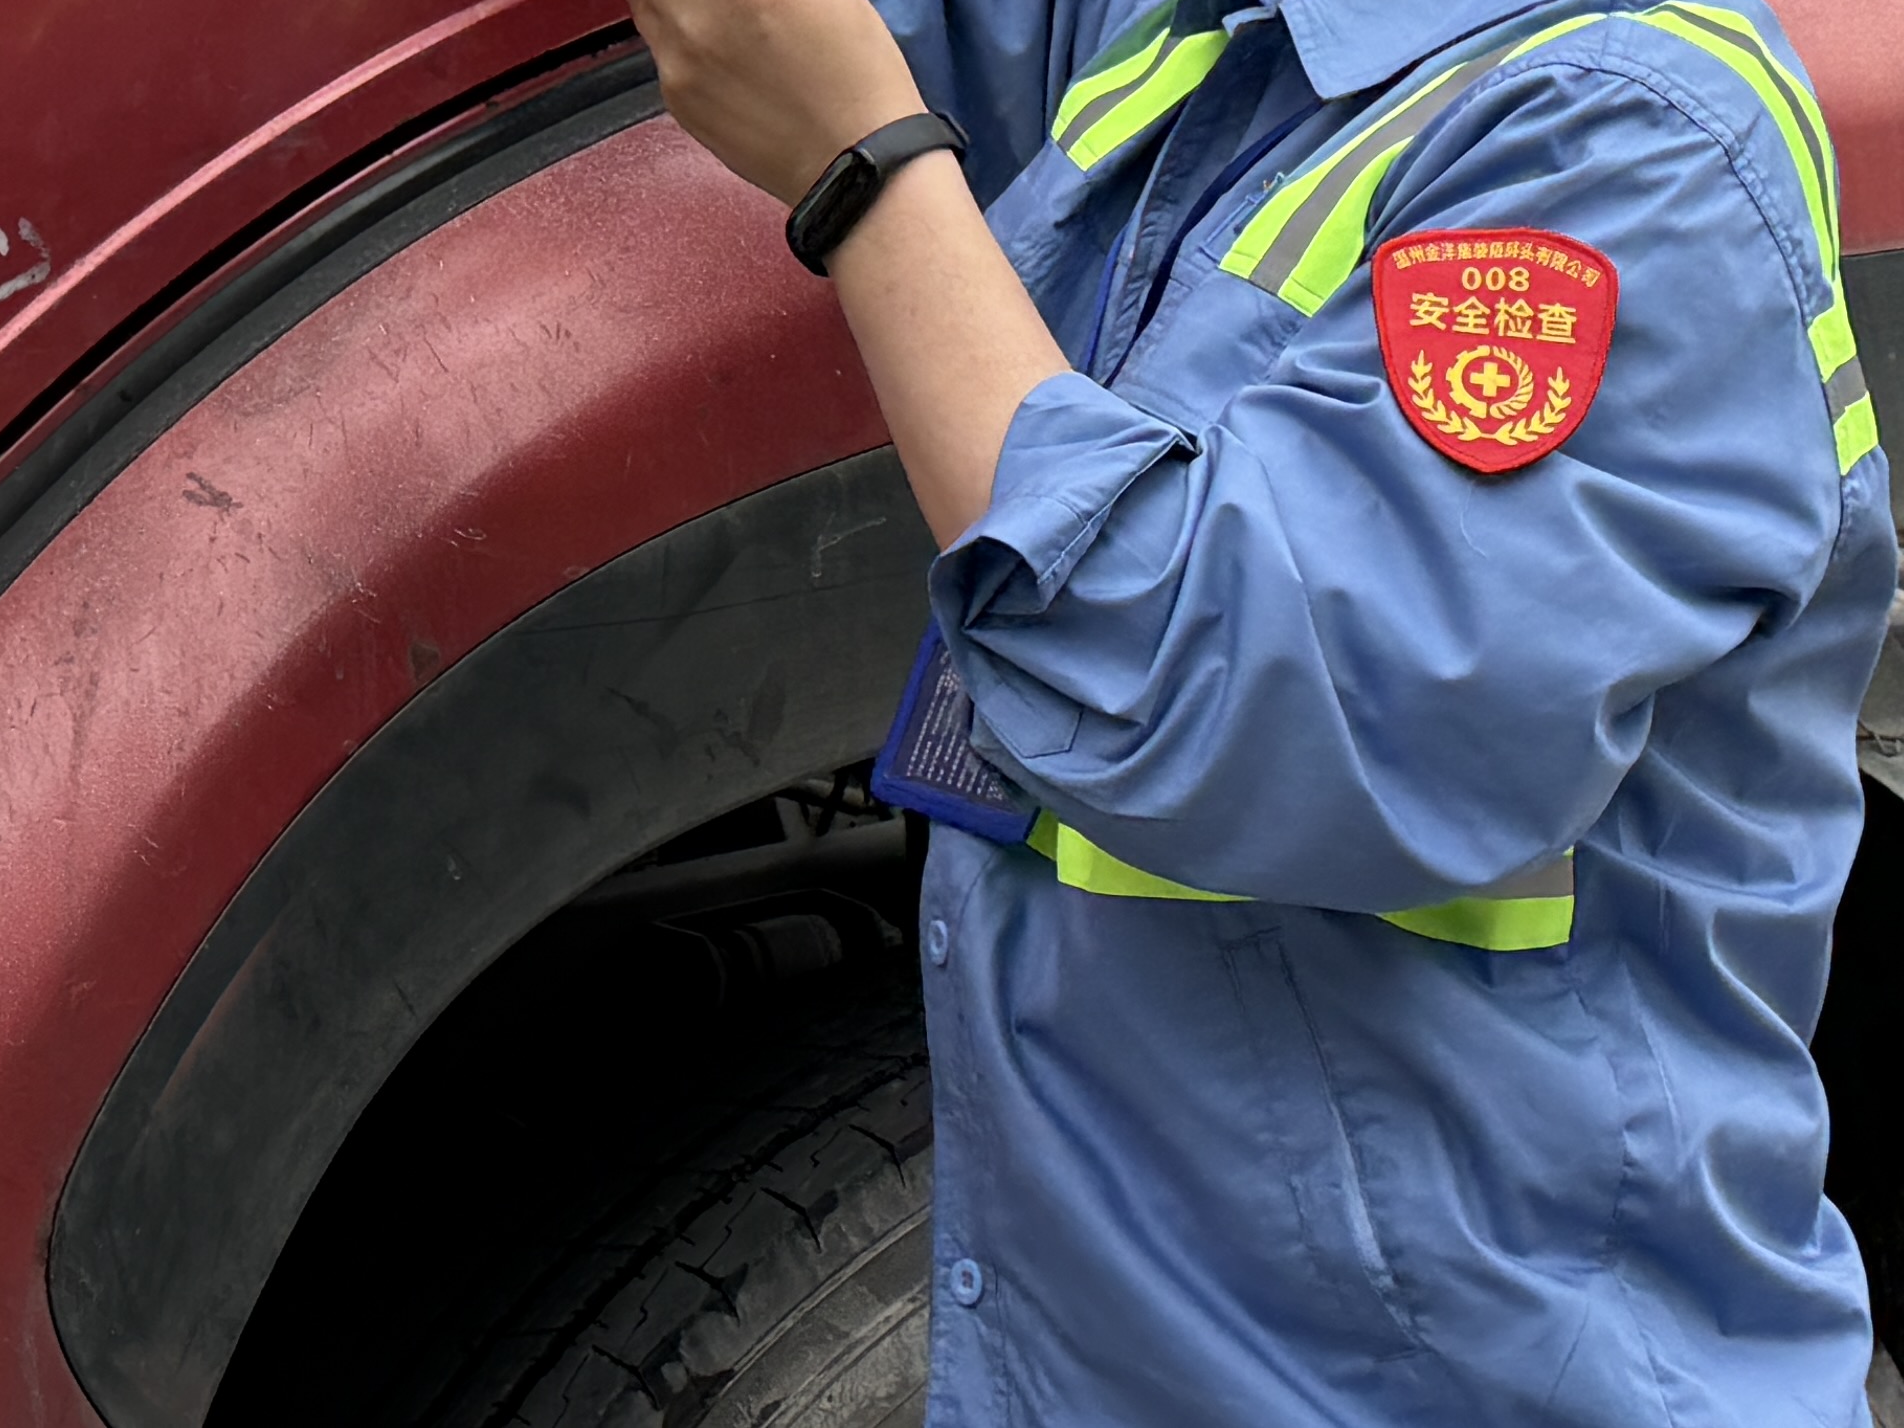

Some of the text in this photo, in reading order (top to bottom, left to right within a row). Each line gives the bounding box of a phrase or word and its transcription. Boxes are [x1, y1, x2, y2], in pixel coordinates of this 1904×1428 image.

[1461, 266, 1531, 292] 008
[1409, 292, 1578, 346] 安全检查
